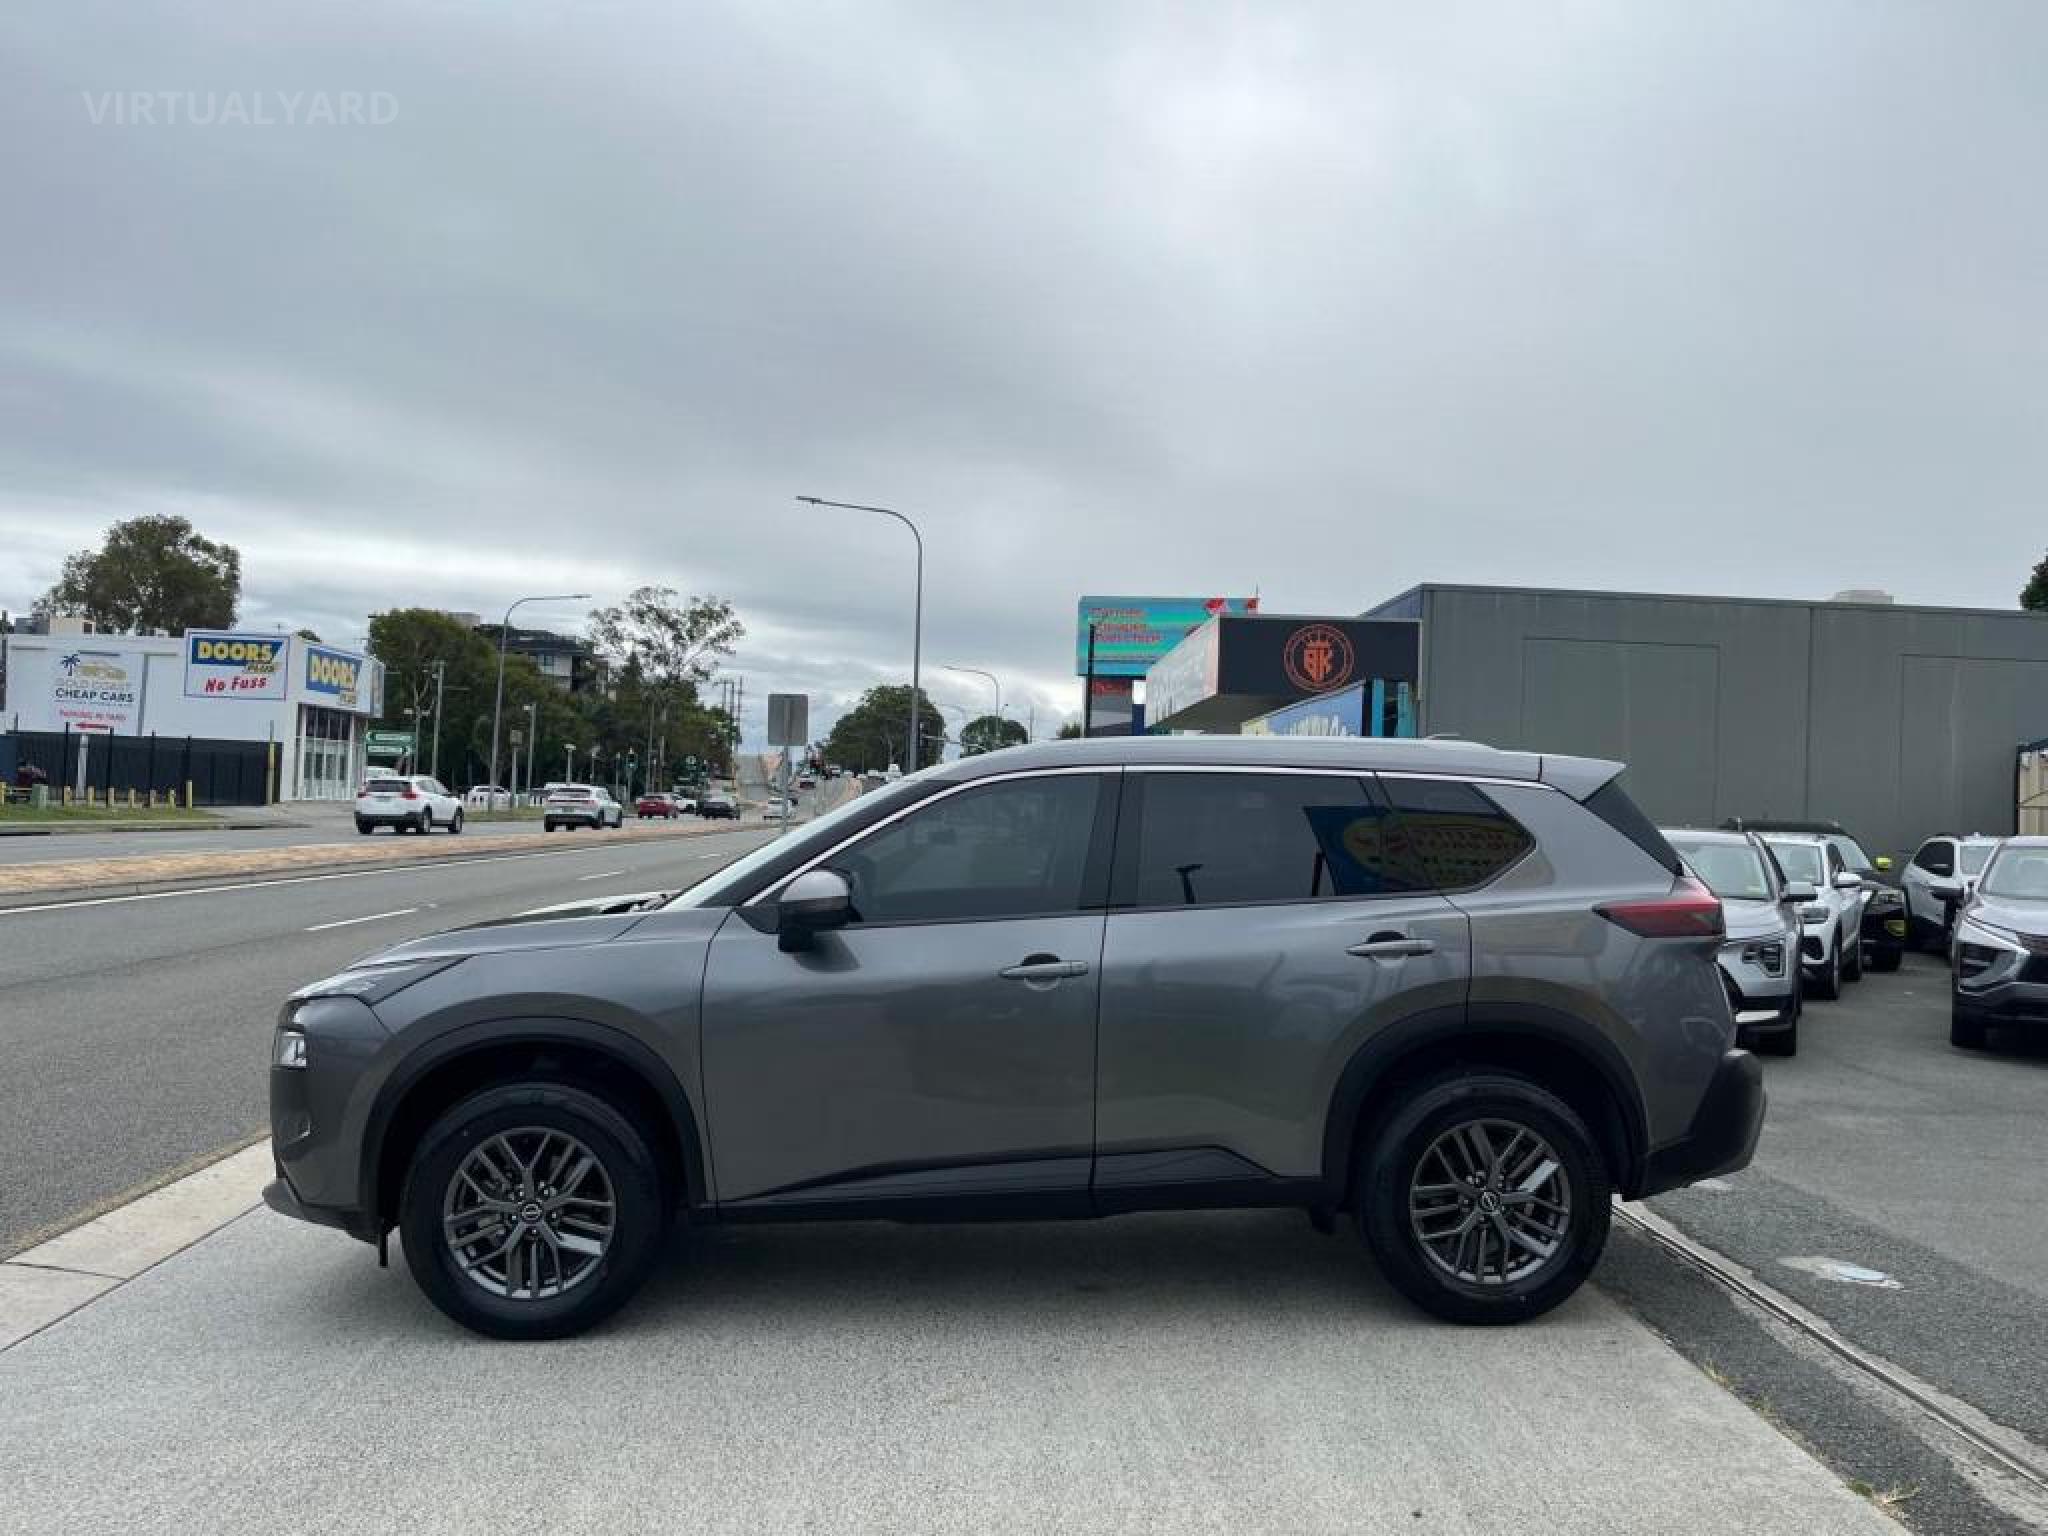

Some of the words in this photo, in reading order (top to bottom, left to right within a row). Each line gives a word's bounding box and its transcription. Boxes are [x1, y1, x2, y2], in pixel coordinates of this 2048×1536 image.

[197, 641, 273, 661] DOORS
[310, 654, 356, 689] DOORS
[205, 678, 226, 693] No
[231, 675, 267, 691] Fuss
[55, 687, 97, 700] CHEAP
[99, 690, 135, 703] CARS
